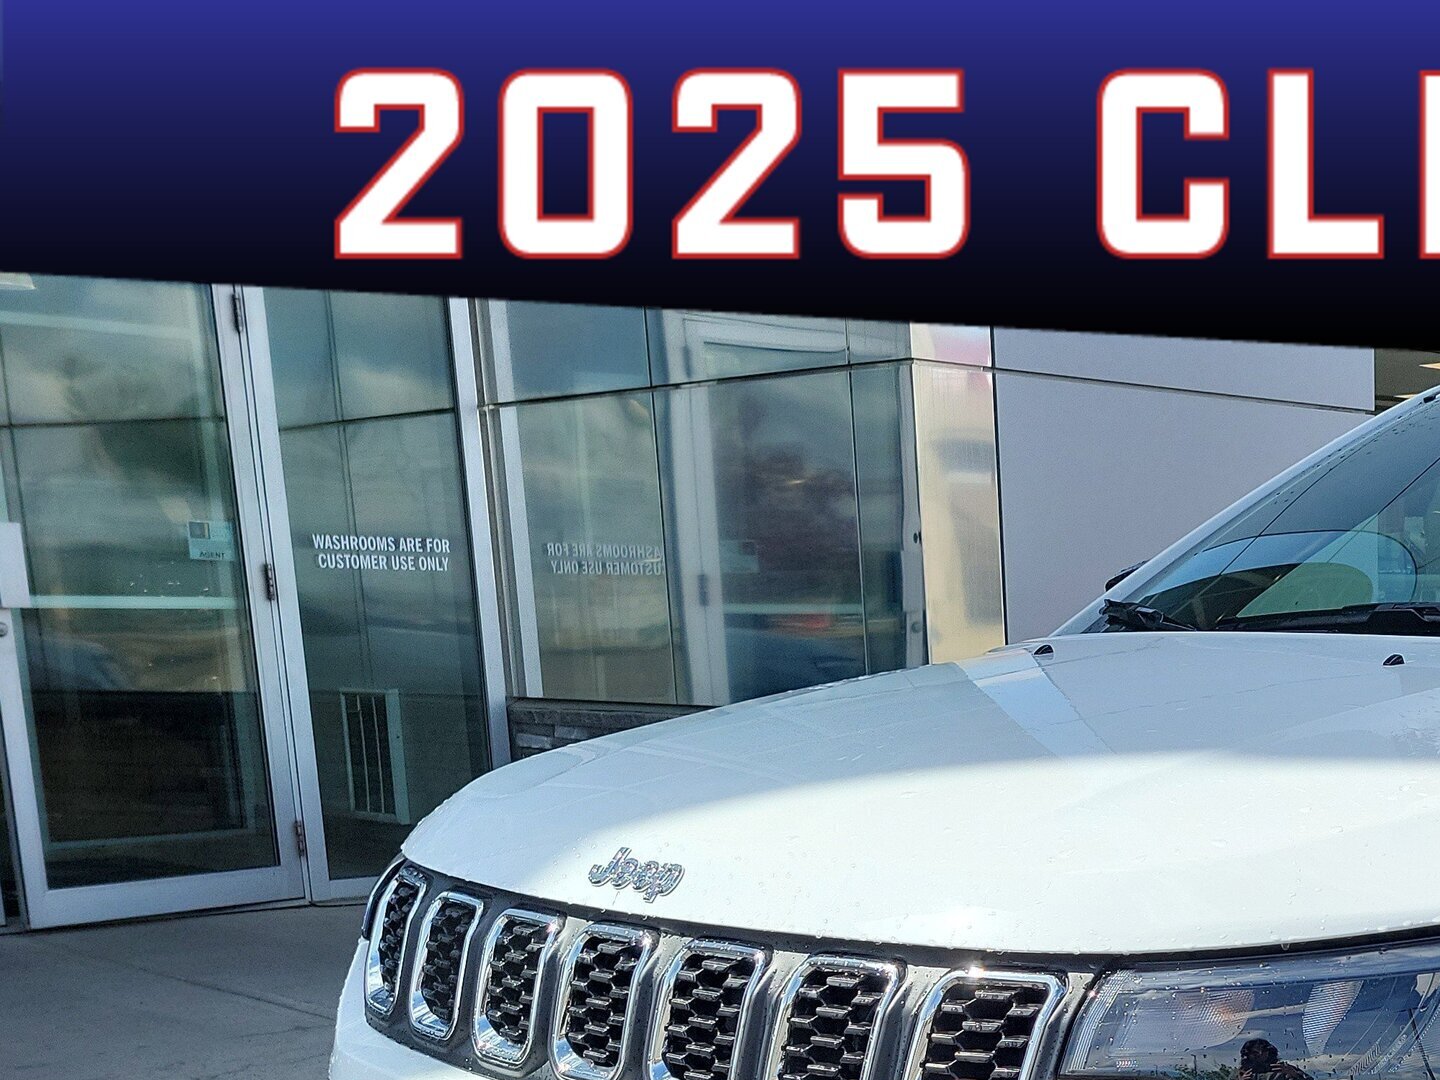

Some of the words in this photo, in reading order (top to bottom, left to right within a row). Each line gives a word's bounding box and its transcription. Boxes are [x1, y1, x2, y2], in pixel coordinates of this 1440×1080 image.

[312, 534, 396, 552] WASHROOMS
[399, 537, 423, 552] ARE
[426, 538, 450, 553] FOR
[318, 553, 388, 570] CUSTOMER
[391, 555, 416, 571] USE
[418, 556, 449, 571] ONLY
[588, 847, 686, 904] Jeep
